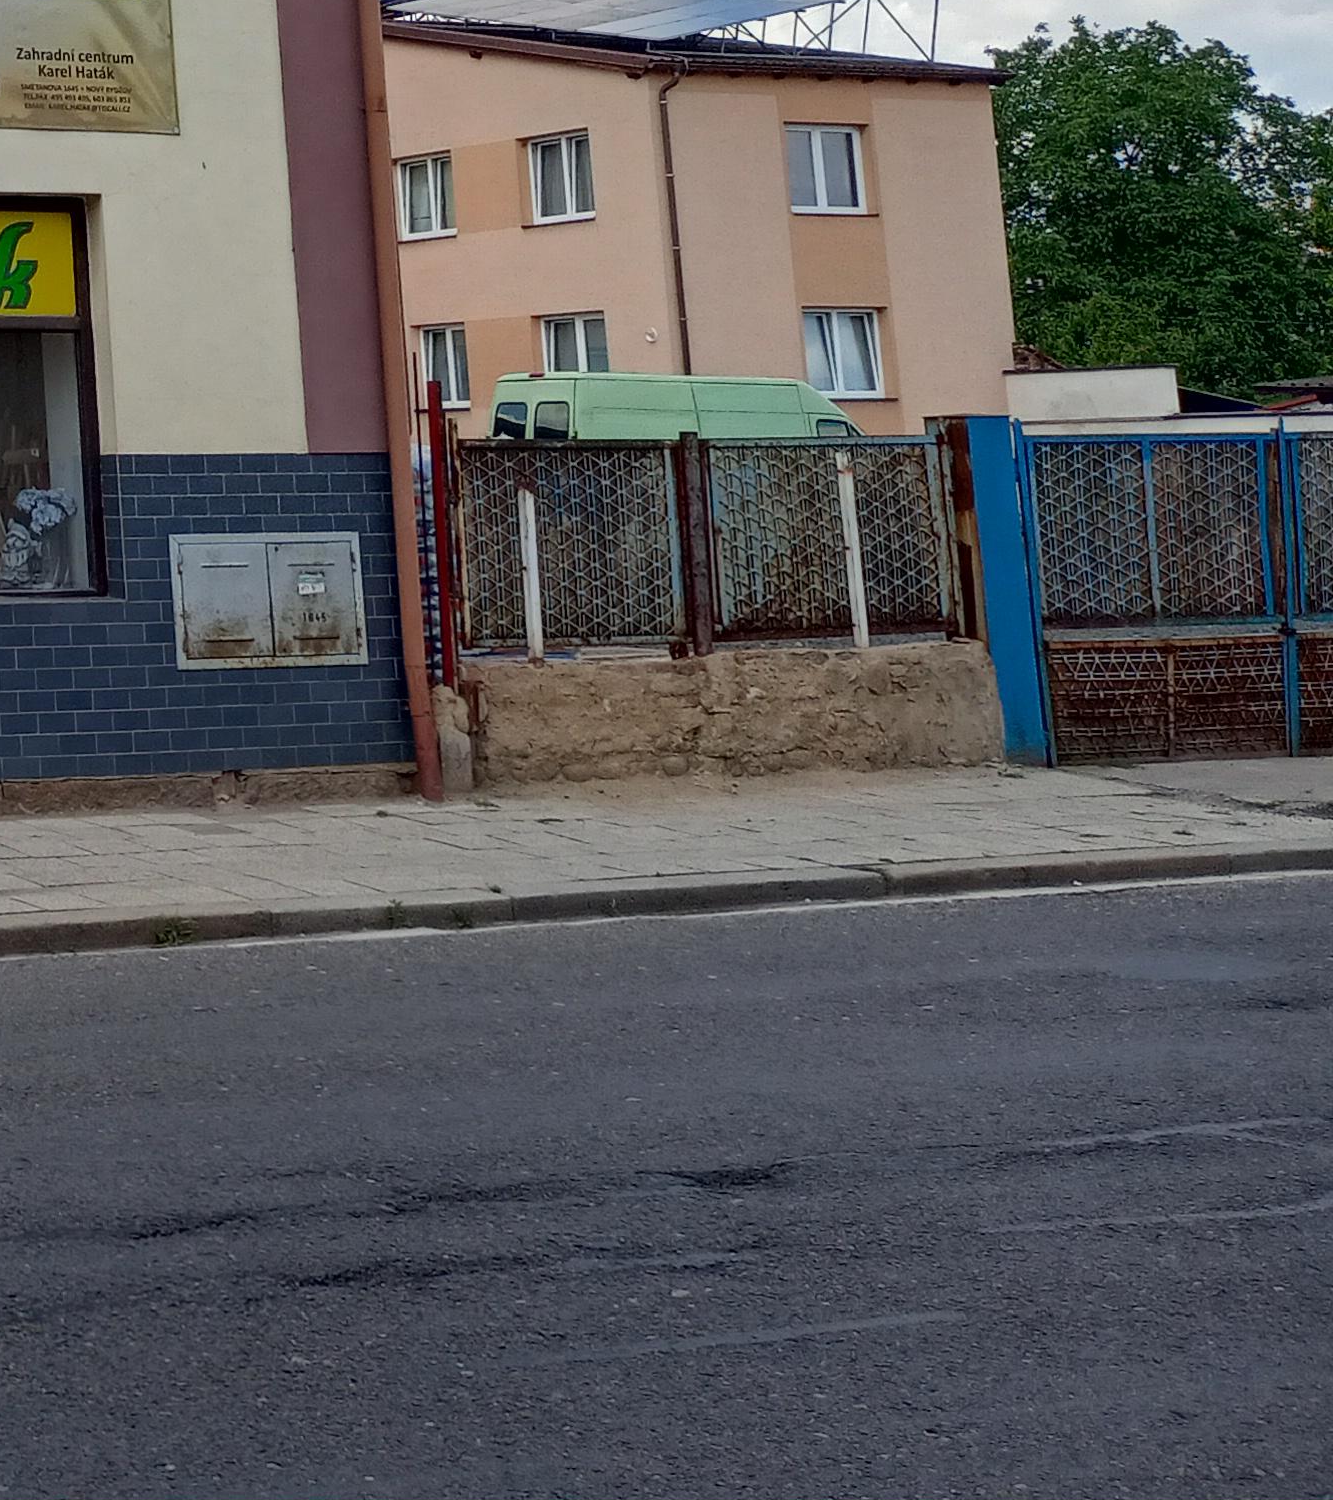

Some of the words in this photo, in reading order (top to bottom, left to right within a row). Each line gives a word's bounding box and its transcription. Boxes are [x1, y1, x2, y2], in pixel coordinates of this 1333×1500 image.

[16, 47, 75, 62] Zahradní
[78, 51, 134, 64] centrum
[38, 64, 72, 78] Karel
[76, 65, 115, 80] Haták
